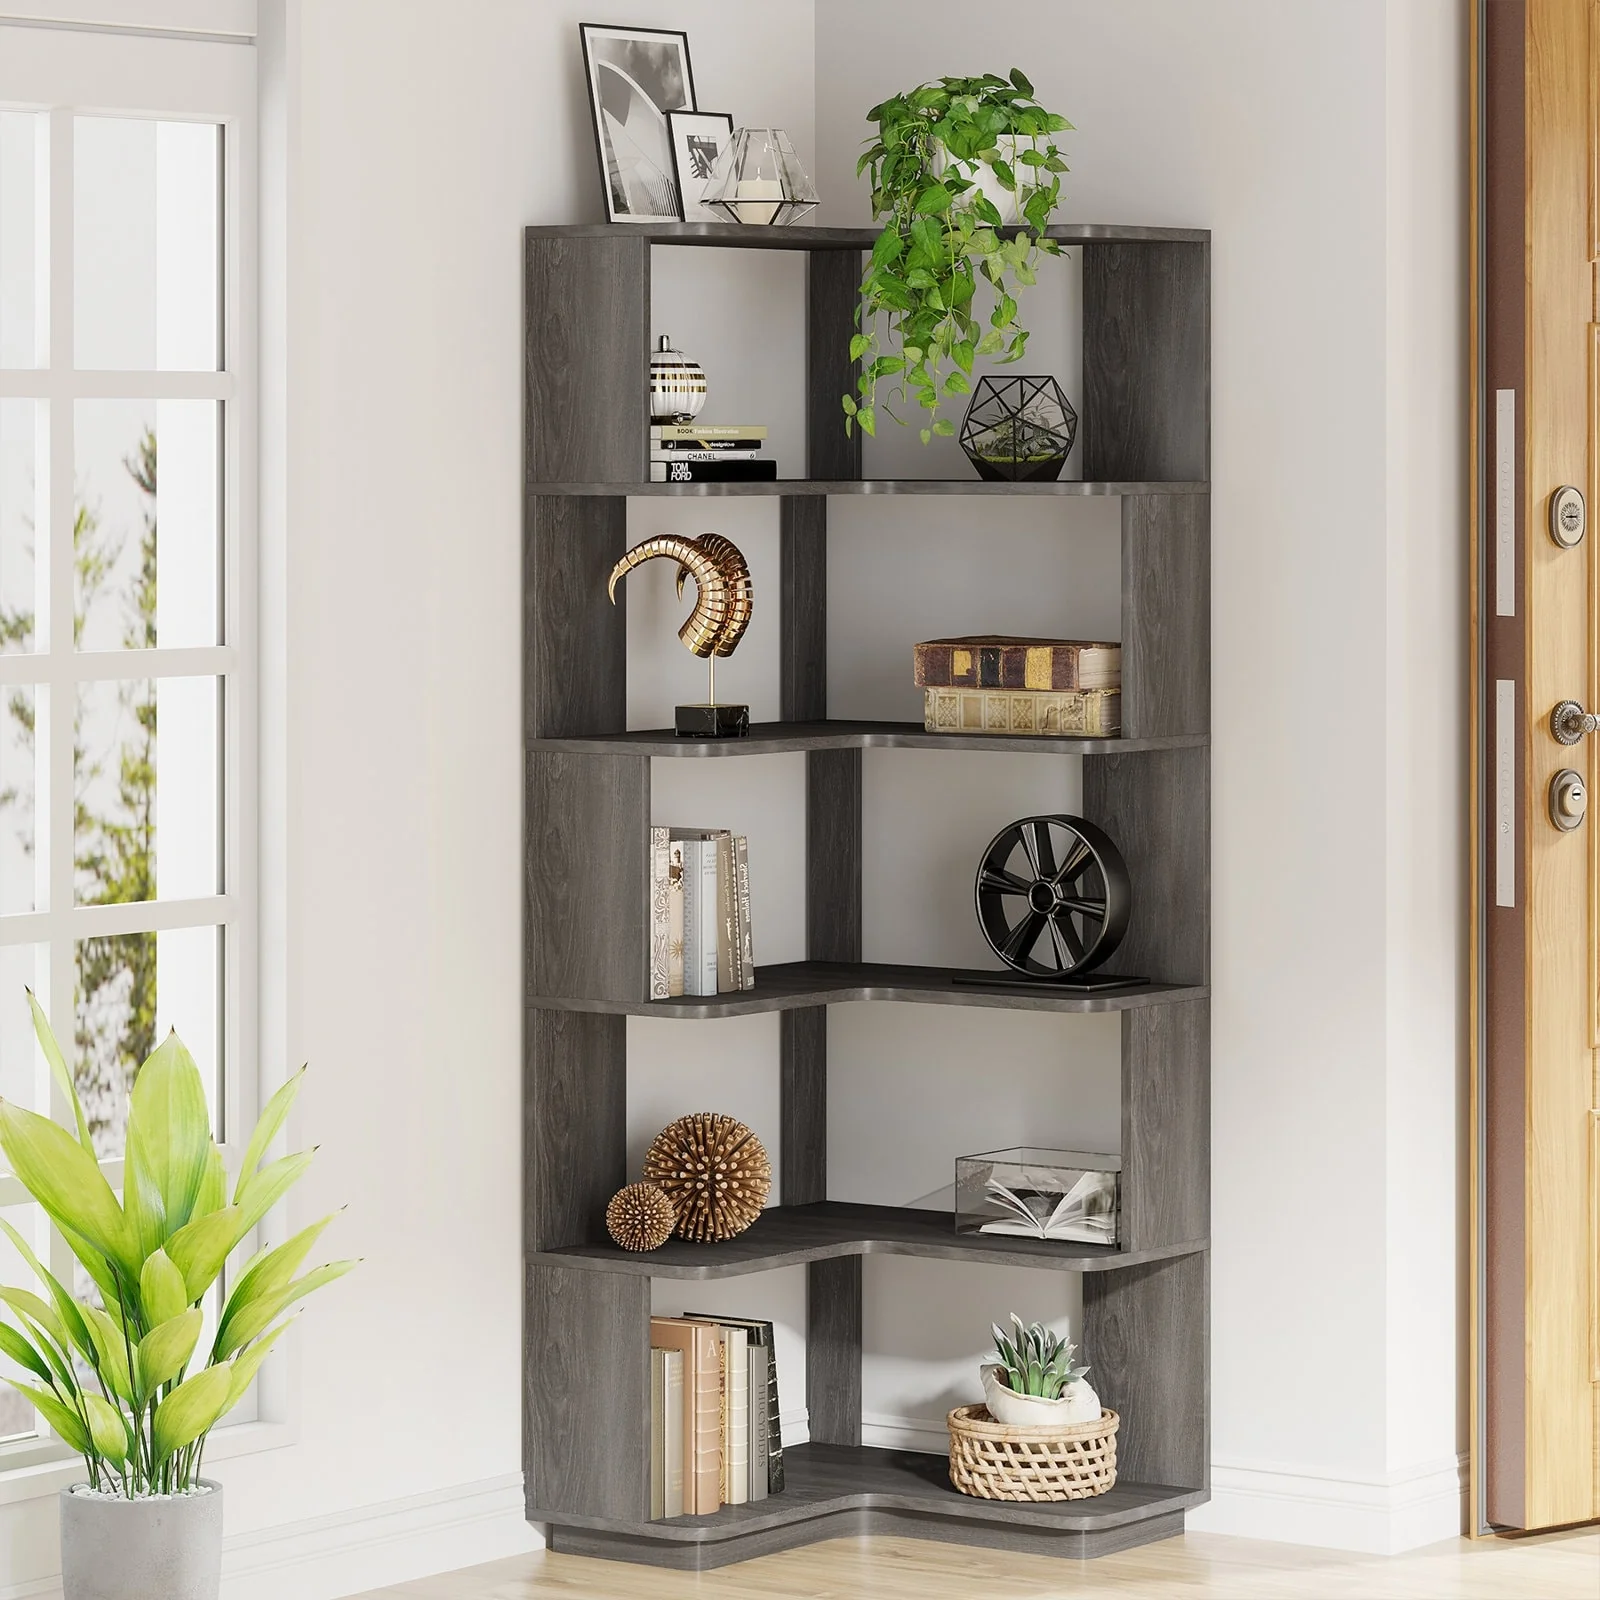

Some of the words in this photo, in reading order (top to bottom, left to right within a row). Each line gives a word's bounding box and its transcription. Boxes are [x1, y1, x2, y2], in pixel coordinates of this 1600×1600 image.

[670, 462, 689, 472] TOM
[670, 471, 692, 481] FORD
[705, 1339, 718, 1358] A
[757, 1381, 766, 1468] THUCYDIDES
